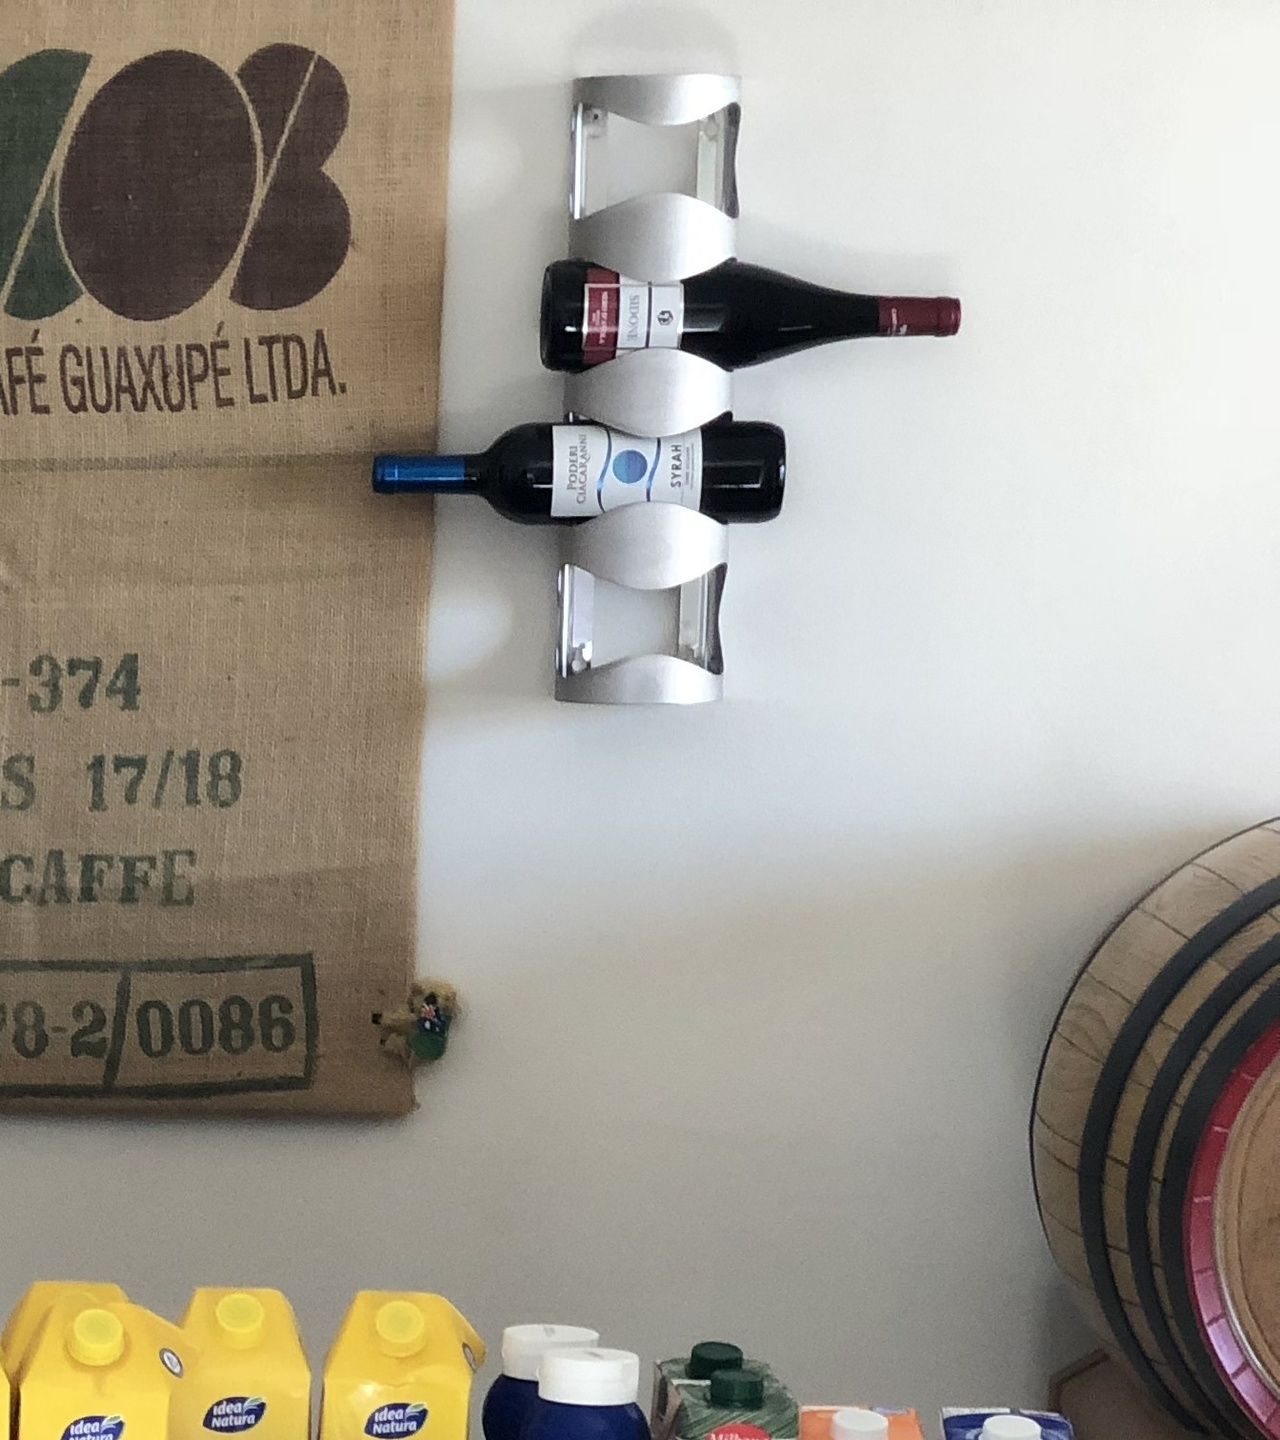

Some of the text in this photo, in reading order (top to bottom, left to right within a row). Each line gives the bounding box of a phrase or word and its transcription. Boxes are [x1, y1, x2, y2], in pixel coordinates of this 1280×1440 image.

[58, 322, 236, 414] GUAXUPÉ
[244, 328, 347, 402] LTDA.
[567, 445, 578, 490] PODERI
[671, 444, 682, 488] SYRAH
[86, 748, 242, 812] 17/18
[211, 1414, 256, 1428] Natura
[372, 1420, 418, 1435] Natura
